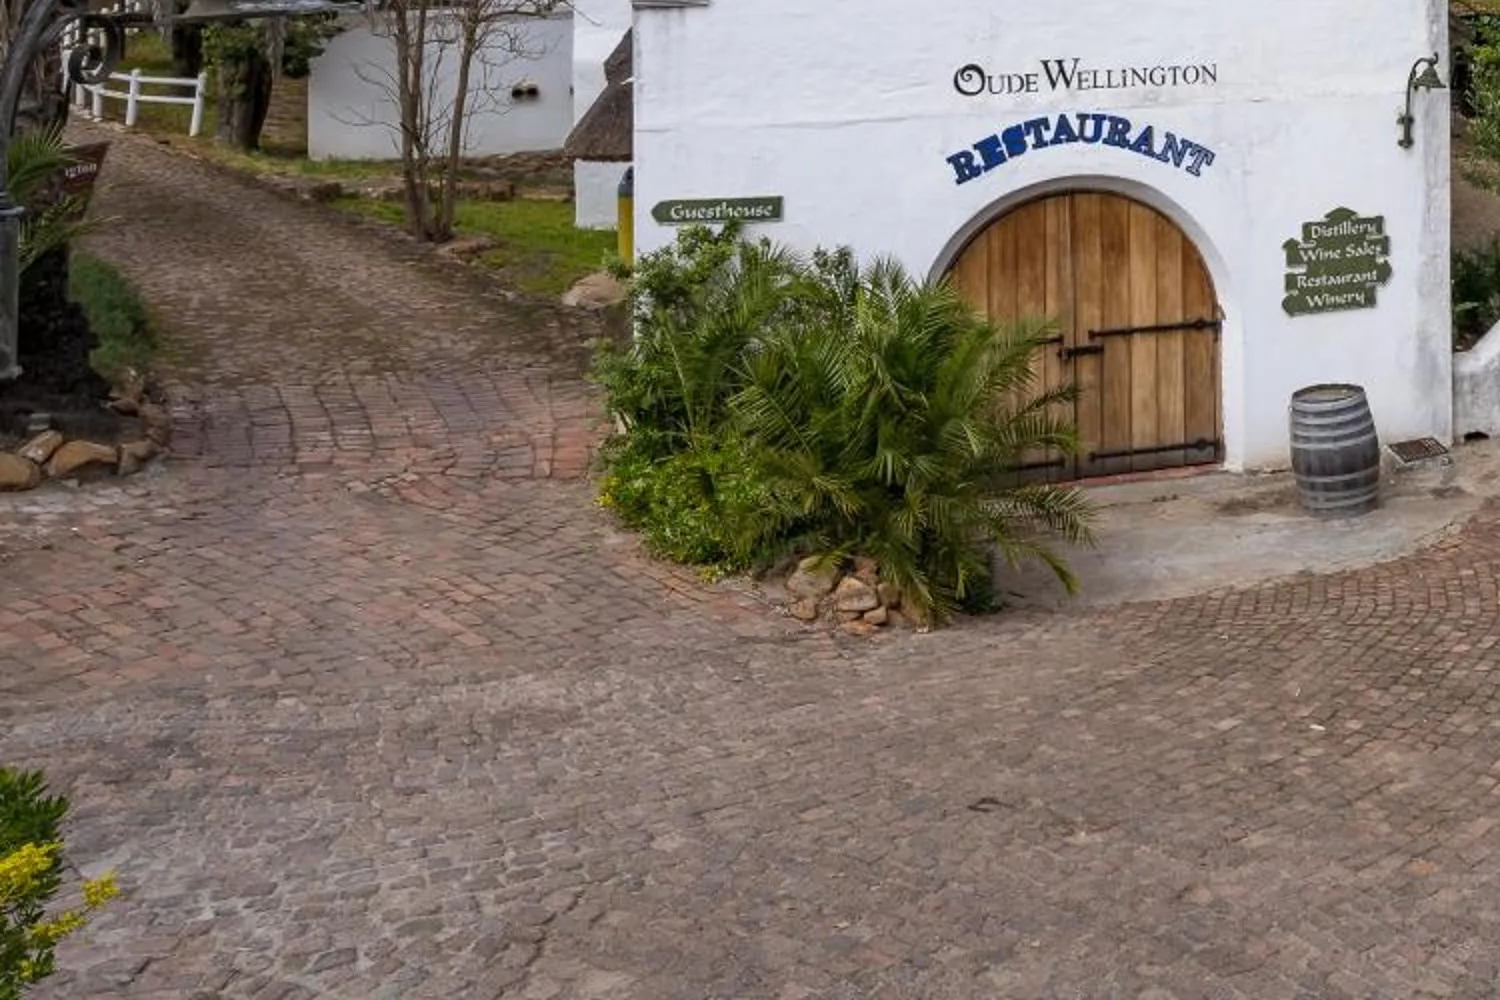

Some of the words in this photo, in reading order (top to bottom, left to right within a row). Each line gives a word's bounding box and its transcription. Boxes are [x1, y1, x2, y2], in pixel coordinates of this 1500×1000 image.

[953, 64, 1039, 96] OUDE
[946, 113, 1216, 185] RESTAURANT
[670, 202, 774, 220] Guesthouse
[1311, 221, 1377, 239] Distillery
[1300, 247, 1341, 261] Wine
[1345, 241, 1382, 257] Sales
[1297, 270, 1377, 288] Restaurant
[1306, 293, 1365, 307] Winery
